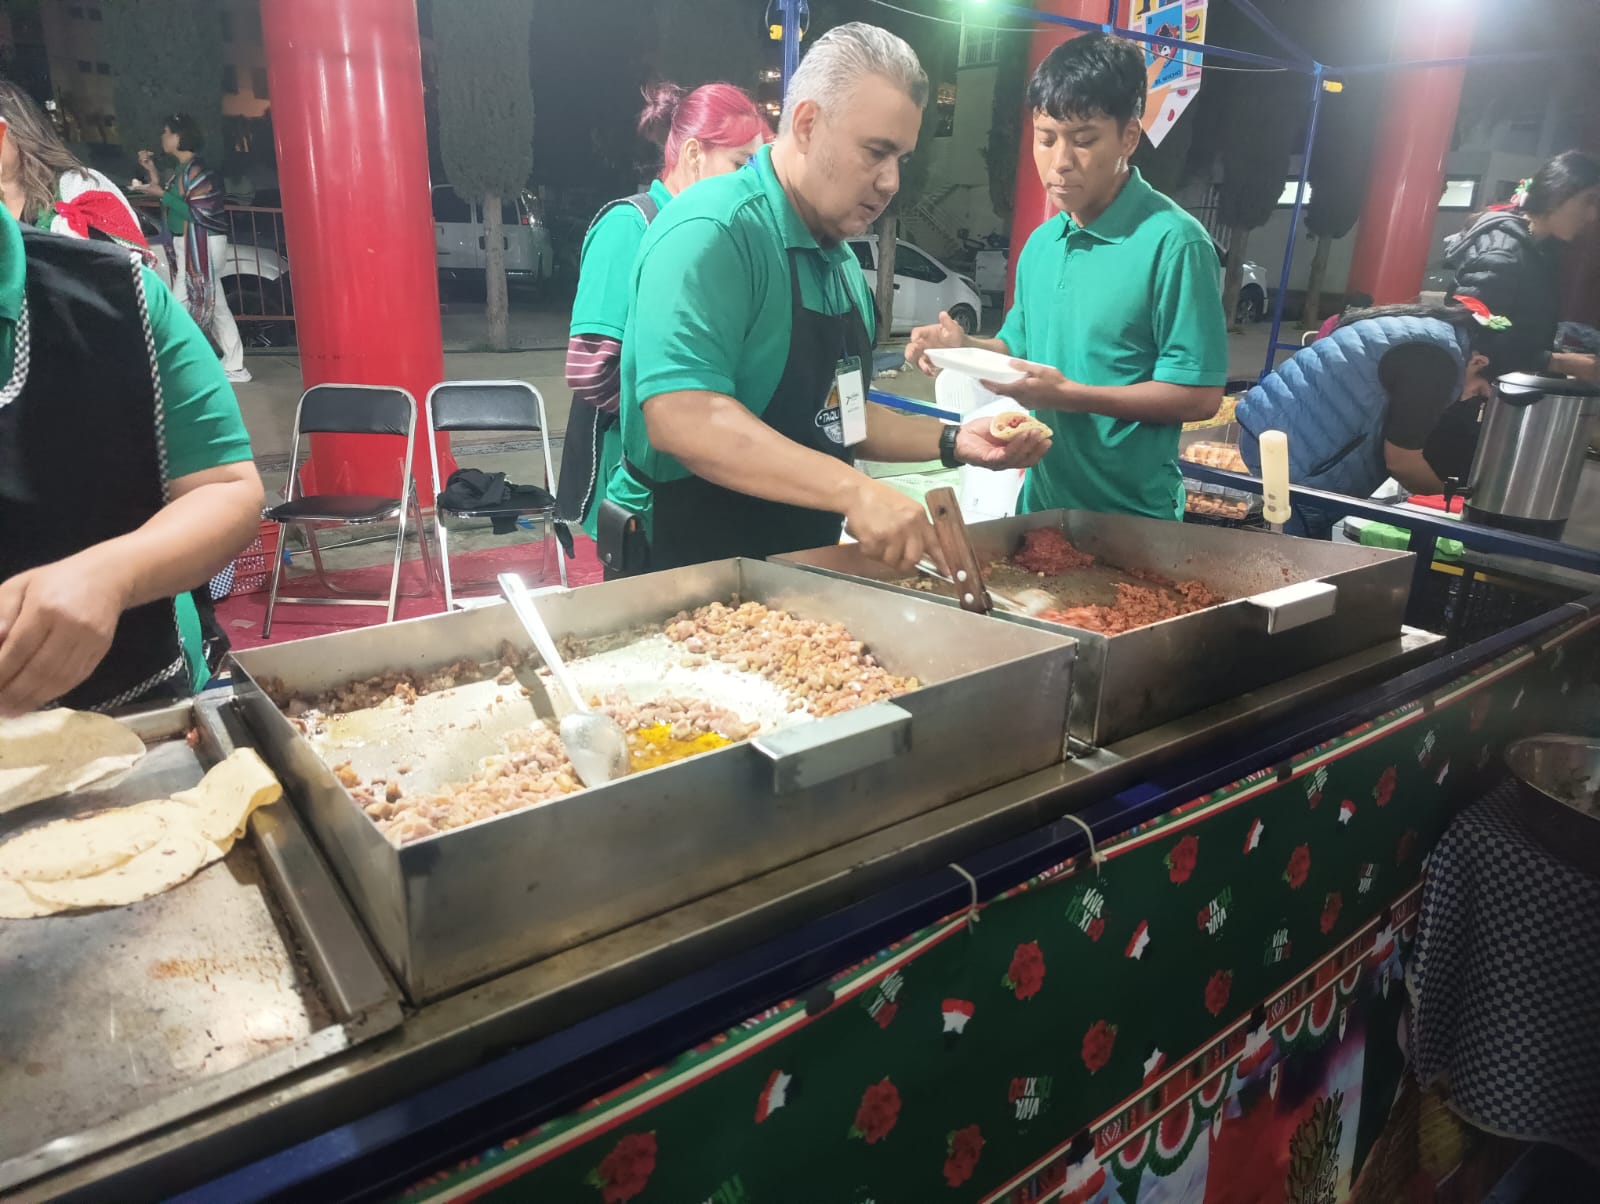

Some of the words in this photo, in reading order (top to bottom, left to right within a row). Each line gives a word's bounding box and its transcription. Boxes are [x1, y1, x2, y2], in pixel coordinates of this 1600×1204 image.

[823, 409, 840, 423] TAQU
[1082, 888, 1105, 919] VIVA
[1205, 908, 1227, 935] VIVA
[1273, 928, 1289, 947] VIVA
